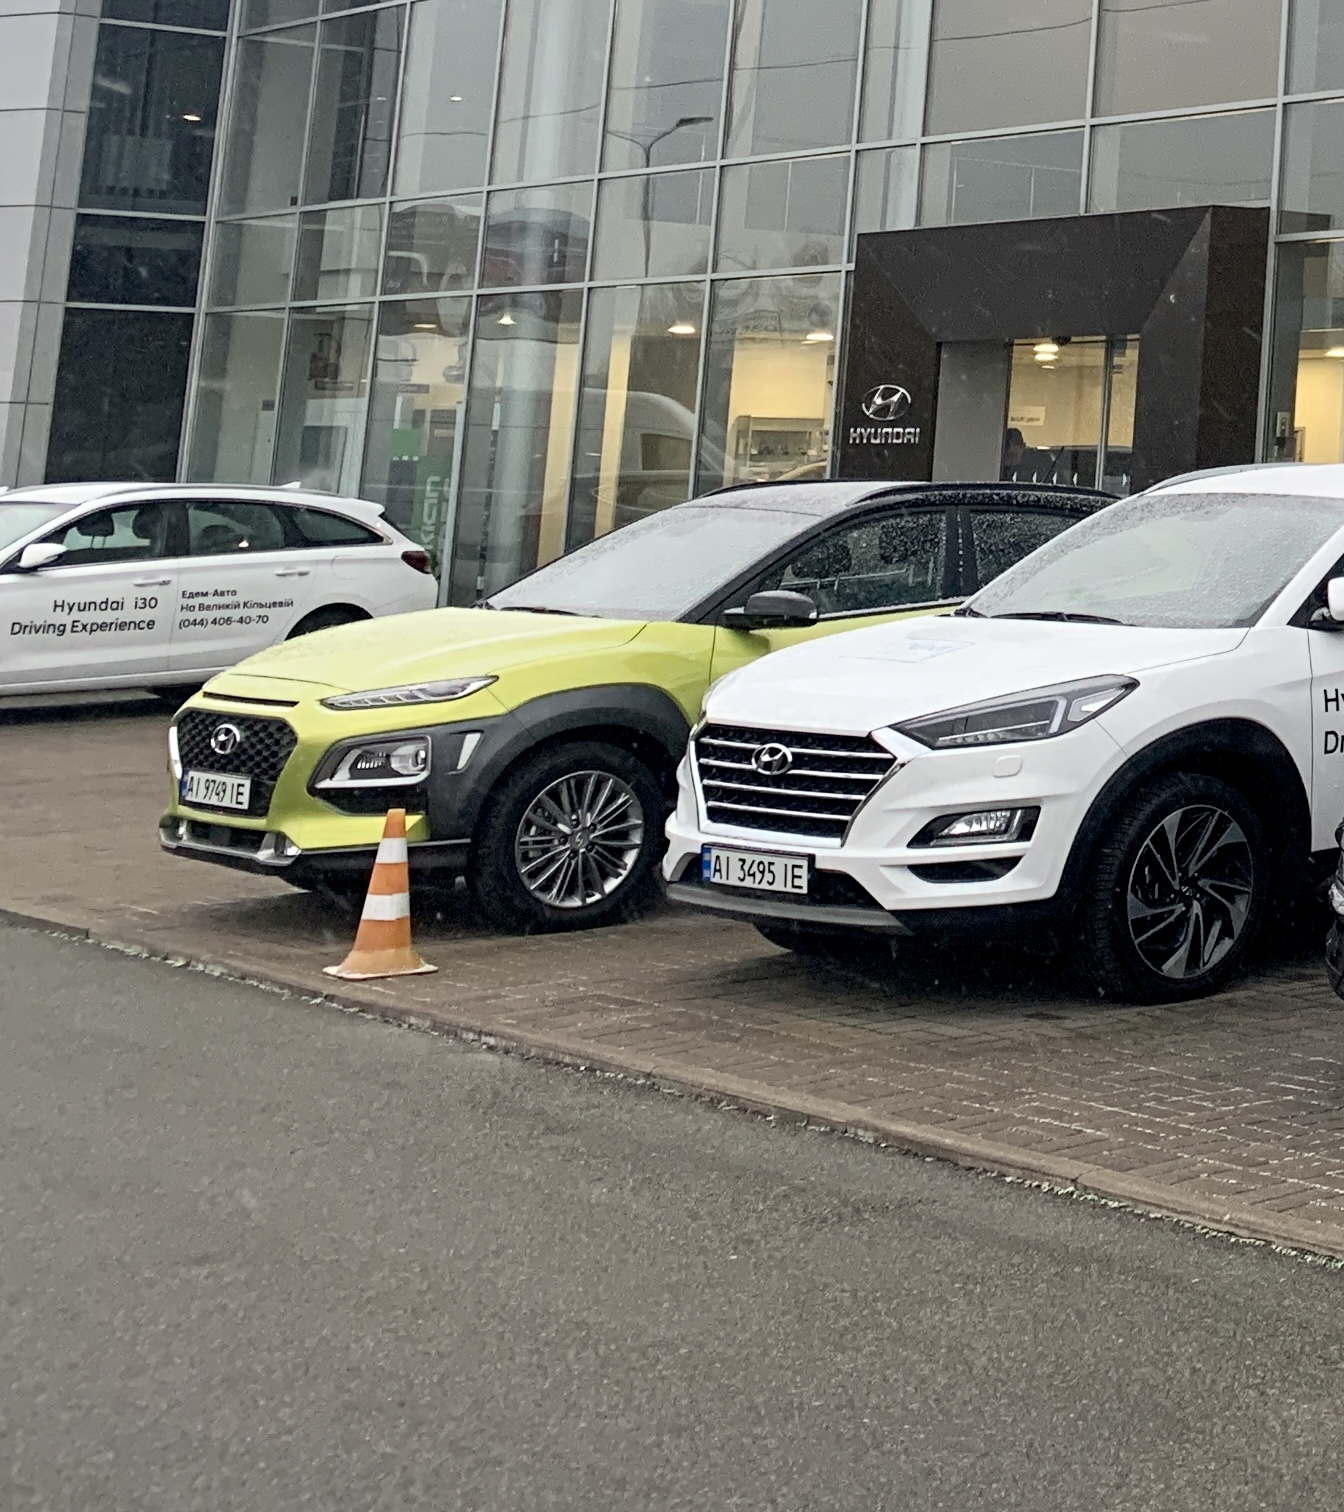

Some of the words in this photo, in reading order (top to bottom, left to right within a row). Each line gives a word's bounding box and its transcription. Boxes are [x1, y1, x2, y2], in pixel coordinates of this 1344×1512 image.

[849, 427, 921, 445] HYUNDAI
[181, 588, 238, 600] Едем-Авто
[52, 597, 125, 616] Hyundai
[134, 596, 159, 610] i30
[198, 599, 241, 612] Великій
[242, 597, 294, 610] Кільцевій
[10, 620, 67, 637] Driving
[70, 617, 156, 634] Experience
[178, 618, 209, 630] (044)
[210, 614, 270, 627] 406-40-70
[203, 778, 228, 803] 9749
[230, 782, 246, 806] IE
[712, 854, 730, 881] AI
[737, 857, 776, 886] 3495
[784, 863, 804, 890] IE
